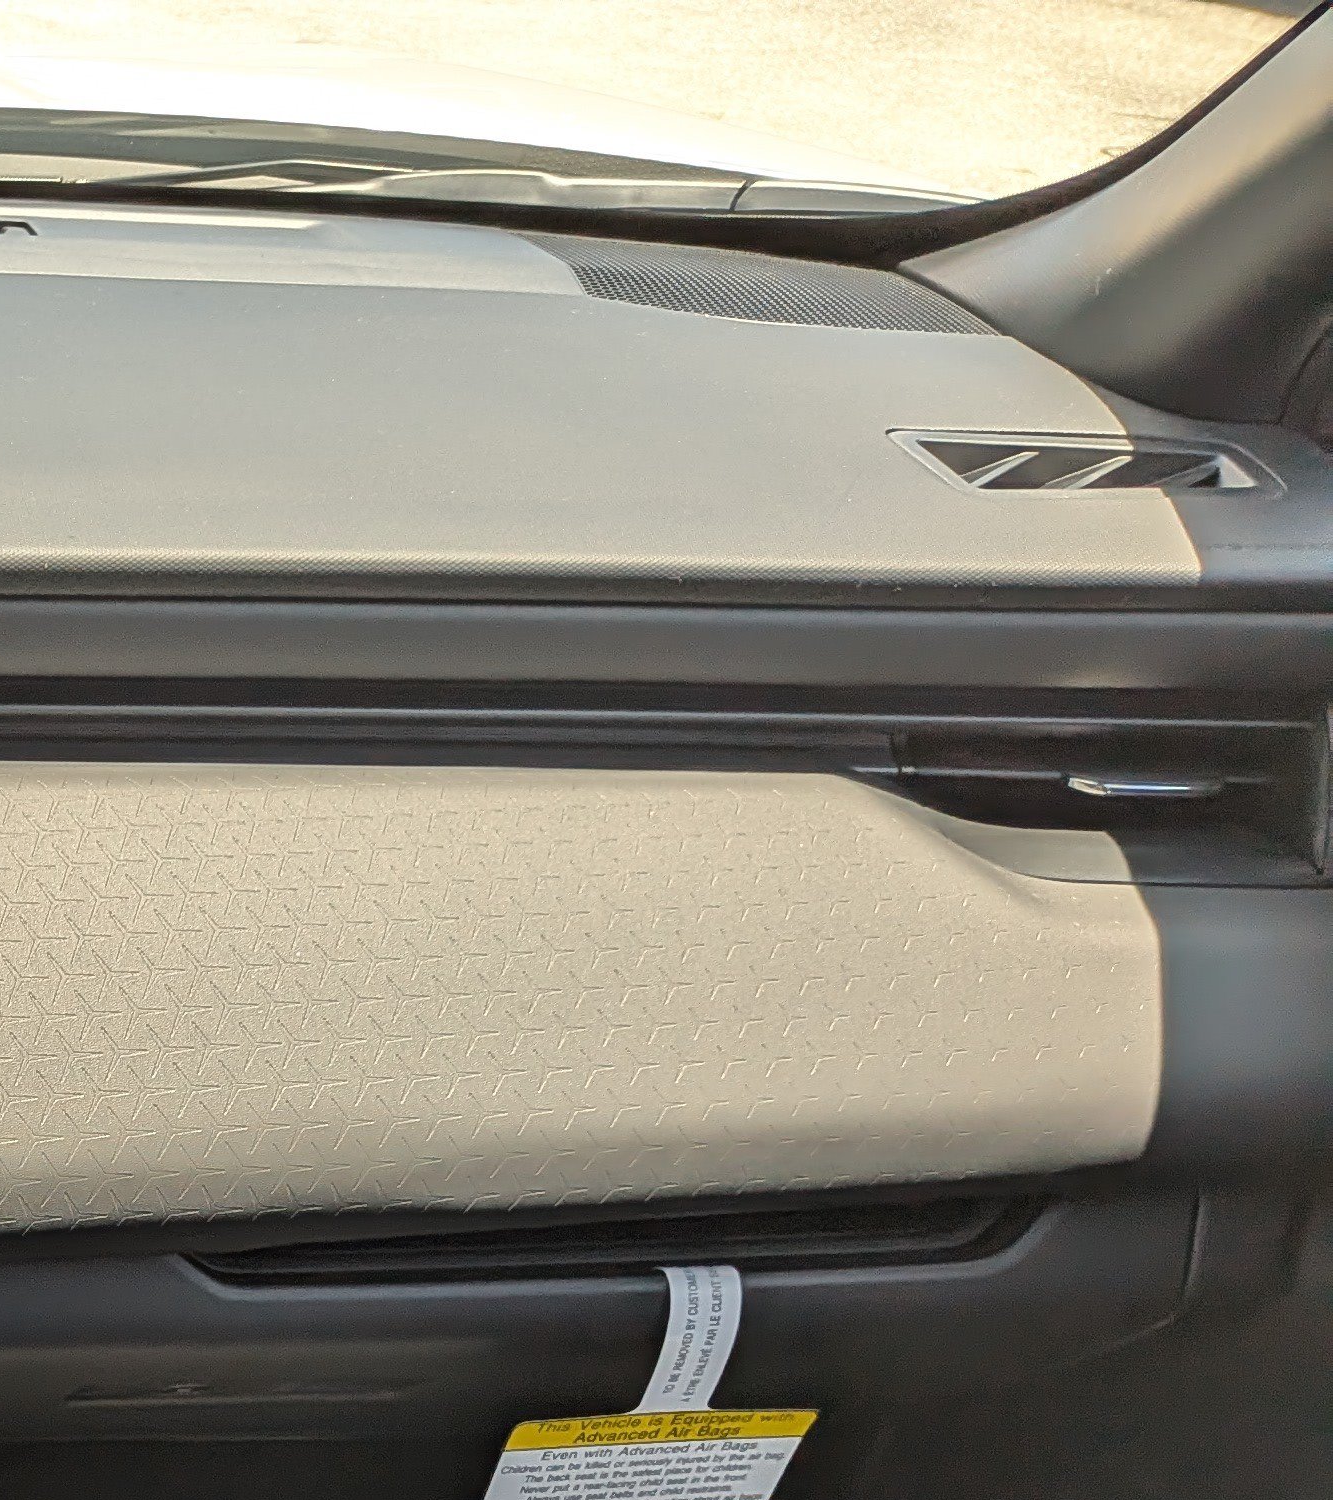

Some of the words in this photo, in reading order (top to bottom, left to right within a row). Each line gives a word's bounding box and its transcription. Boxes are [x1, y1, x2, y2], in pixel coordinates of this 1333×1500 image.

[686, 1318, 696, 1331] BY
[709, 1315, 722, 1328] LE
[704, 1328, 719, 1346] PAR
[537, 1422, 571, 1434] This
[581, 1417, 642, 1431] Vehicle
[648, 1415, 663, 1426] is
[670, 1412, 753, 1427] Equipped
[760, 1412, 795, 1422] with
[573, 1427, 660, 1444] Advanced
[665, 1427, 692, 1439] Air
[696, 1425, 741, 1438] Bags
[540, 1450, 578, 1461] Even
[584, 1448, 613, 1459] with
[618, 1443, 690, 1456] Advanced
[695, 1442, 717, 1452] Air
[721, 1441, 759, 1453] Bags
